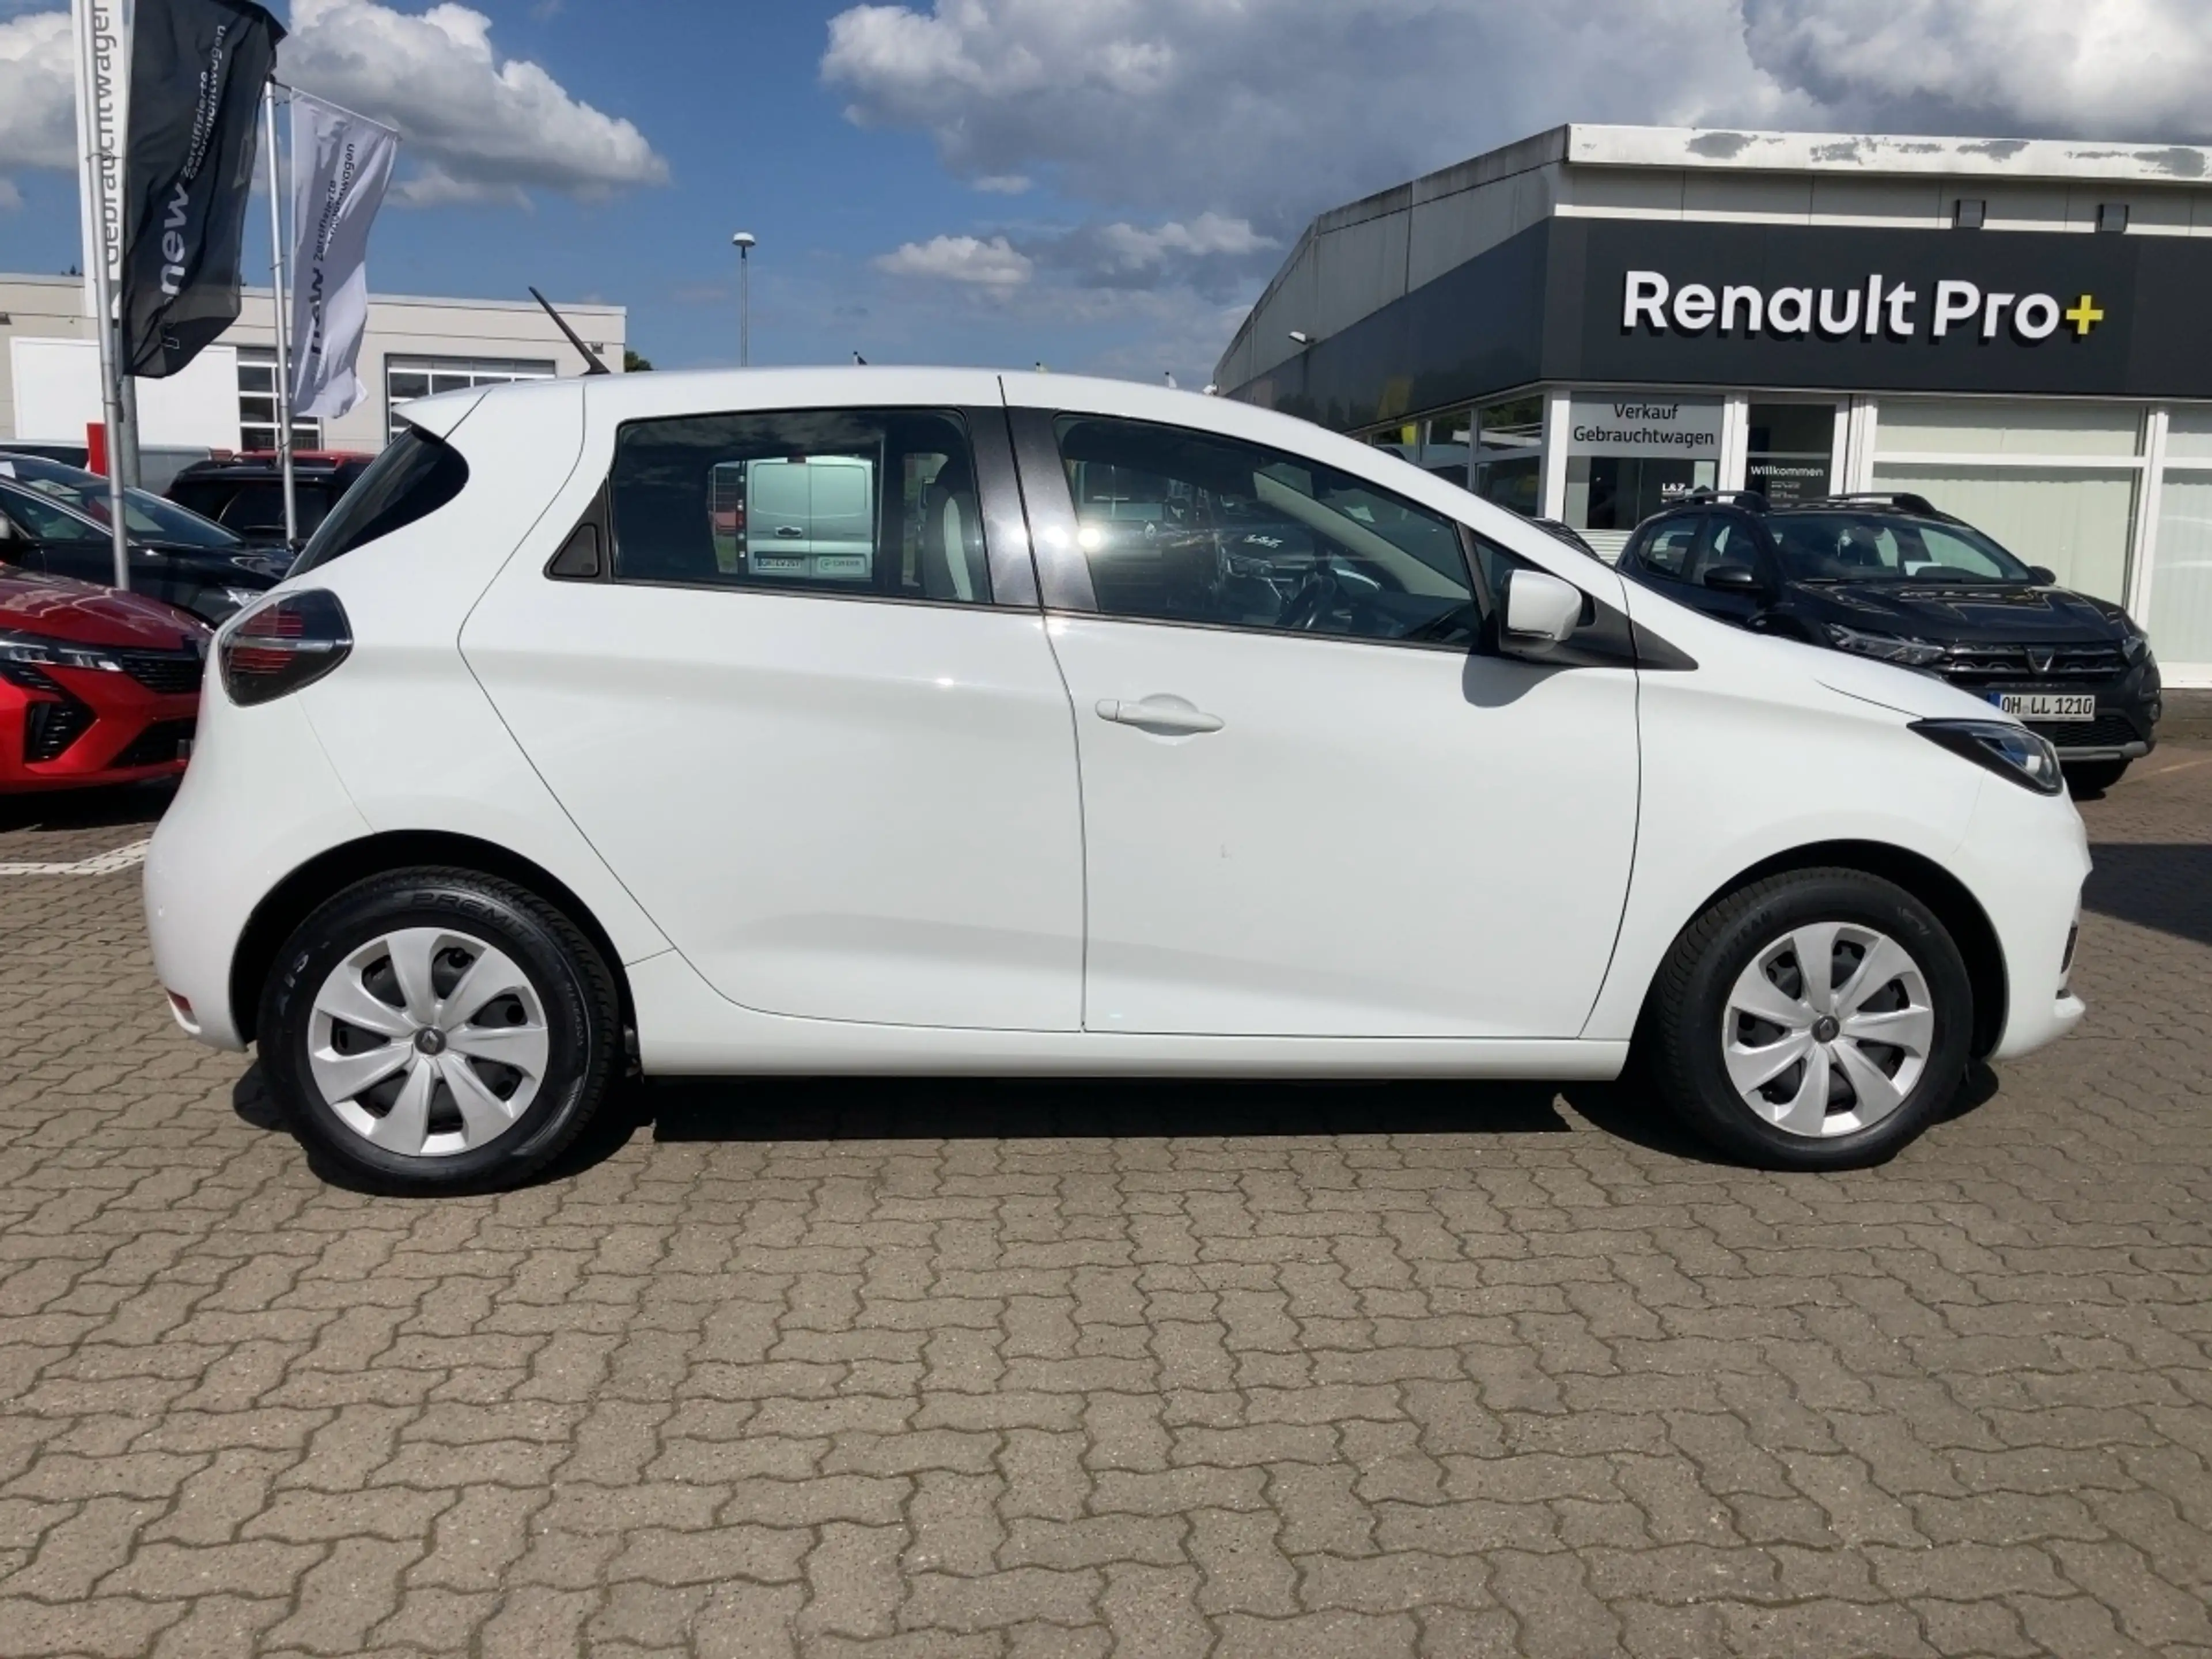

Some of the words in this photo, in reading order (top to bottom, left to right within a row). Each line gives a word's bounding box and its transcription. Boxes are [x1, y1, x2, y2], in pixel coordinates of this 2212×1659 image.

[1623, 270, 1916, 335] Renault
[1934, 280, 2104, 339] Pro+
[1613, 403, 1679, 420] Verkauf
[1574, 426, 1714, 448] Gebrauchtwagen
[1751, 465, 1824, 476] Willkommen
[2002, 696, 2021, 714] OH
[2031, 697, 2051, 714] LL
[2055, 697, 2093, 715] 1210
